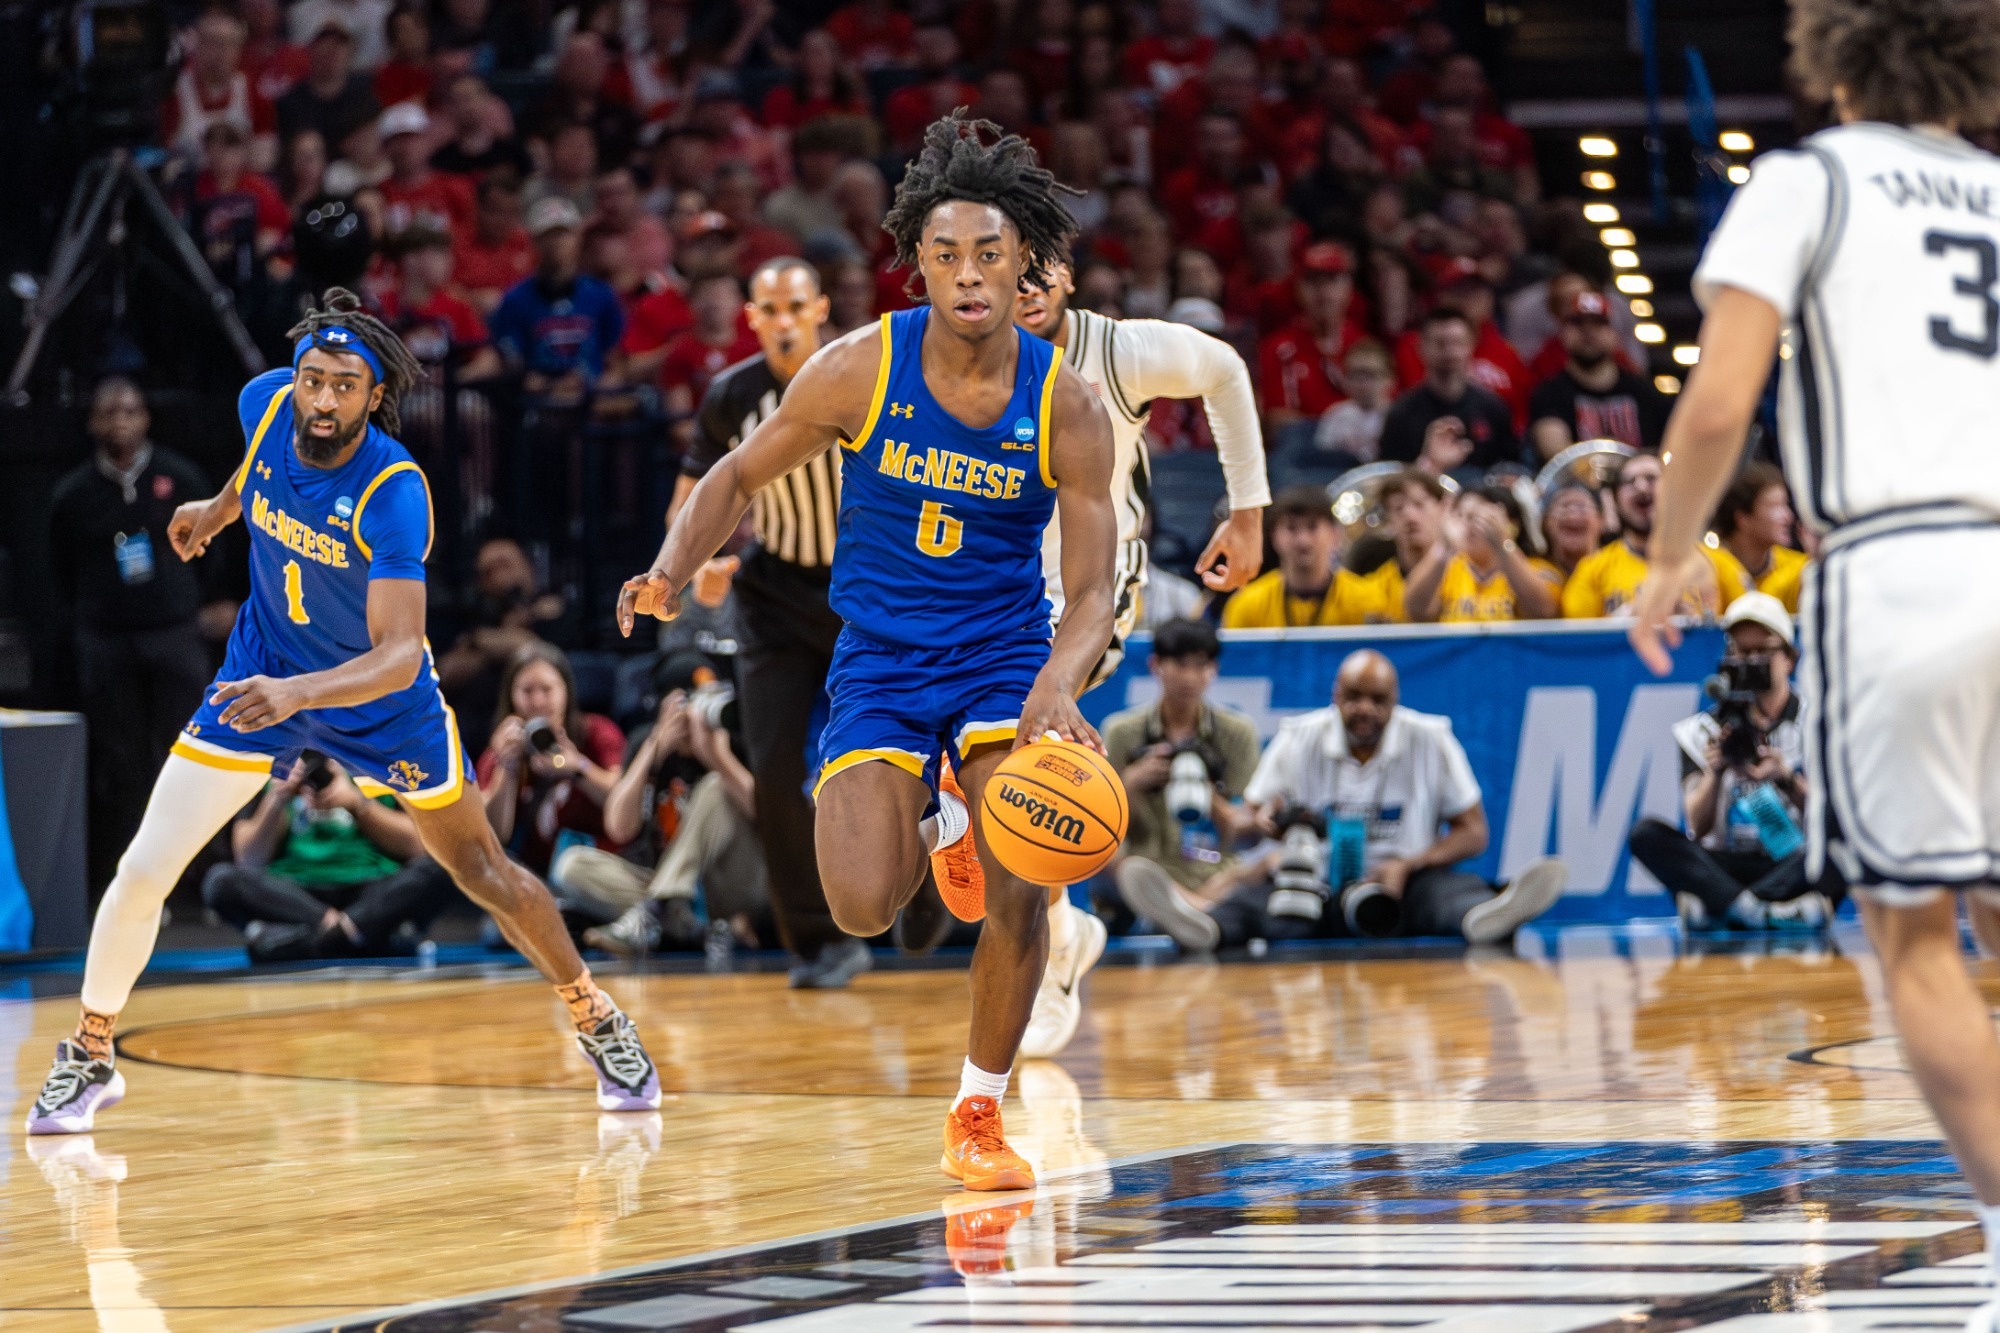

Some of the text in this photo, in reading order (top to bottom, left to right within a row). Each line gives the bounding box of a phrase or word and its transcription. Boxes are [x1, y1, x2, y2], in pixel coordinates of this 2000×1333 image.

[1923, 227, 1999, 361] 3
[878, 438, 1026, 499] McNEESE
[915, 499, 964, 558] 6
[283, 559, 310, 624] 1
[1000, 783, 1085, 846] Wilson
